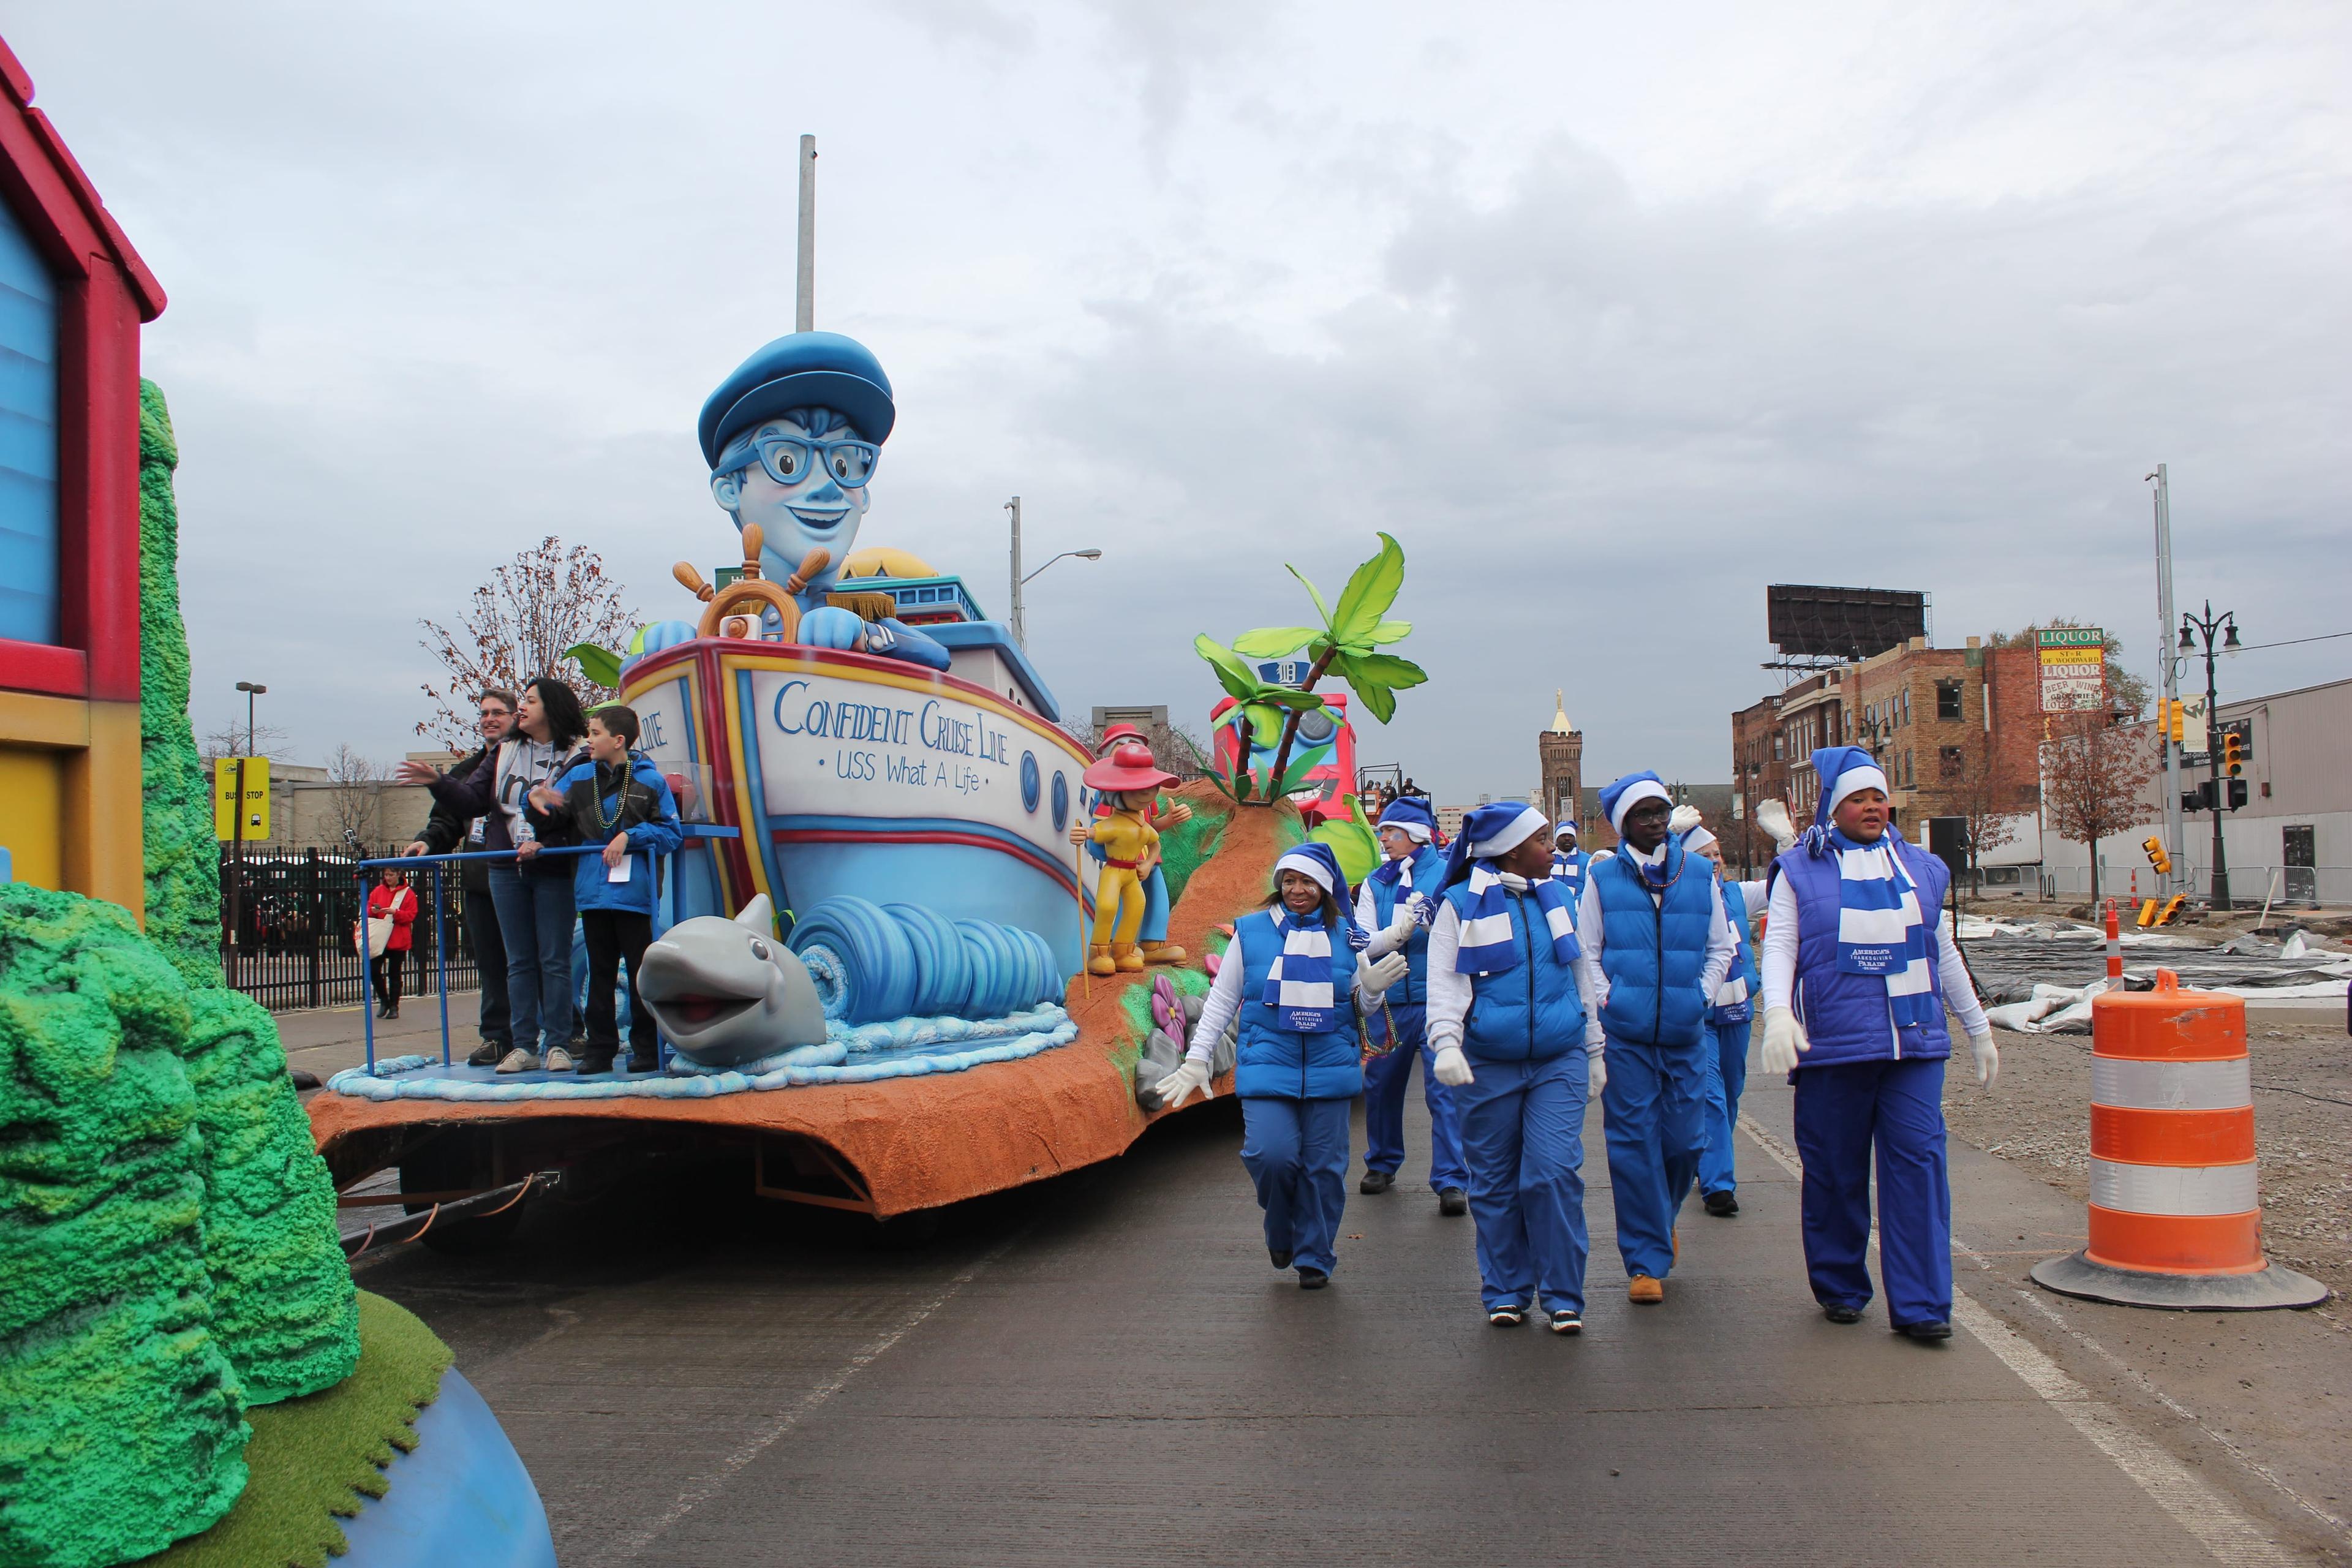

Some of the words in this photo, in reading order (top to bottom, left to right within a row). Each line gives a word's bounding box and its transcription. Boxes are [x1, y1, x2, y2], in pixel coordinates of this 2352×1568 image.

[2040, 631, 2101, 645] LIQUOR
[2043, 665, 2100, 679] LIQUOR
[2045, 680, 2068, 694] BEER
[2076, 680, 2100, 693] WINE
[837, 750, 876, 781] USS
[887, 754, 927, 786] What
[934, 761, 948, 788] A
[956, 764, 979, 796] Life
[246, 791, 263, 799] STOP
